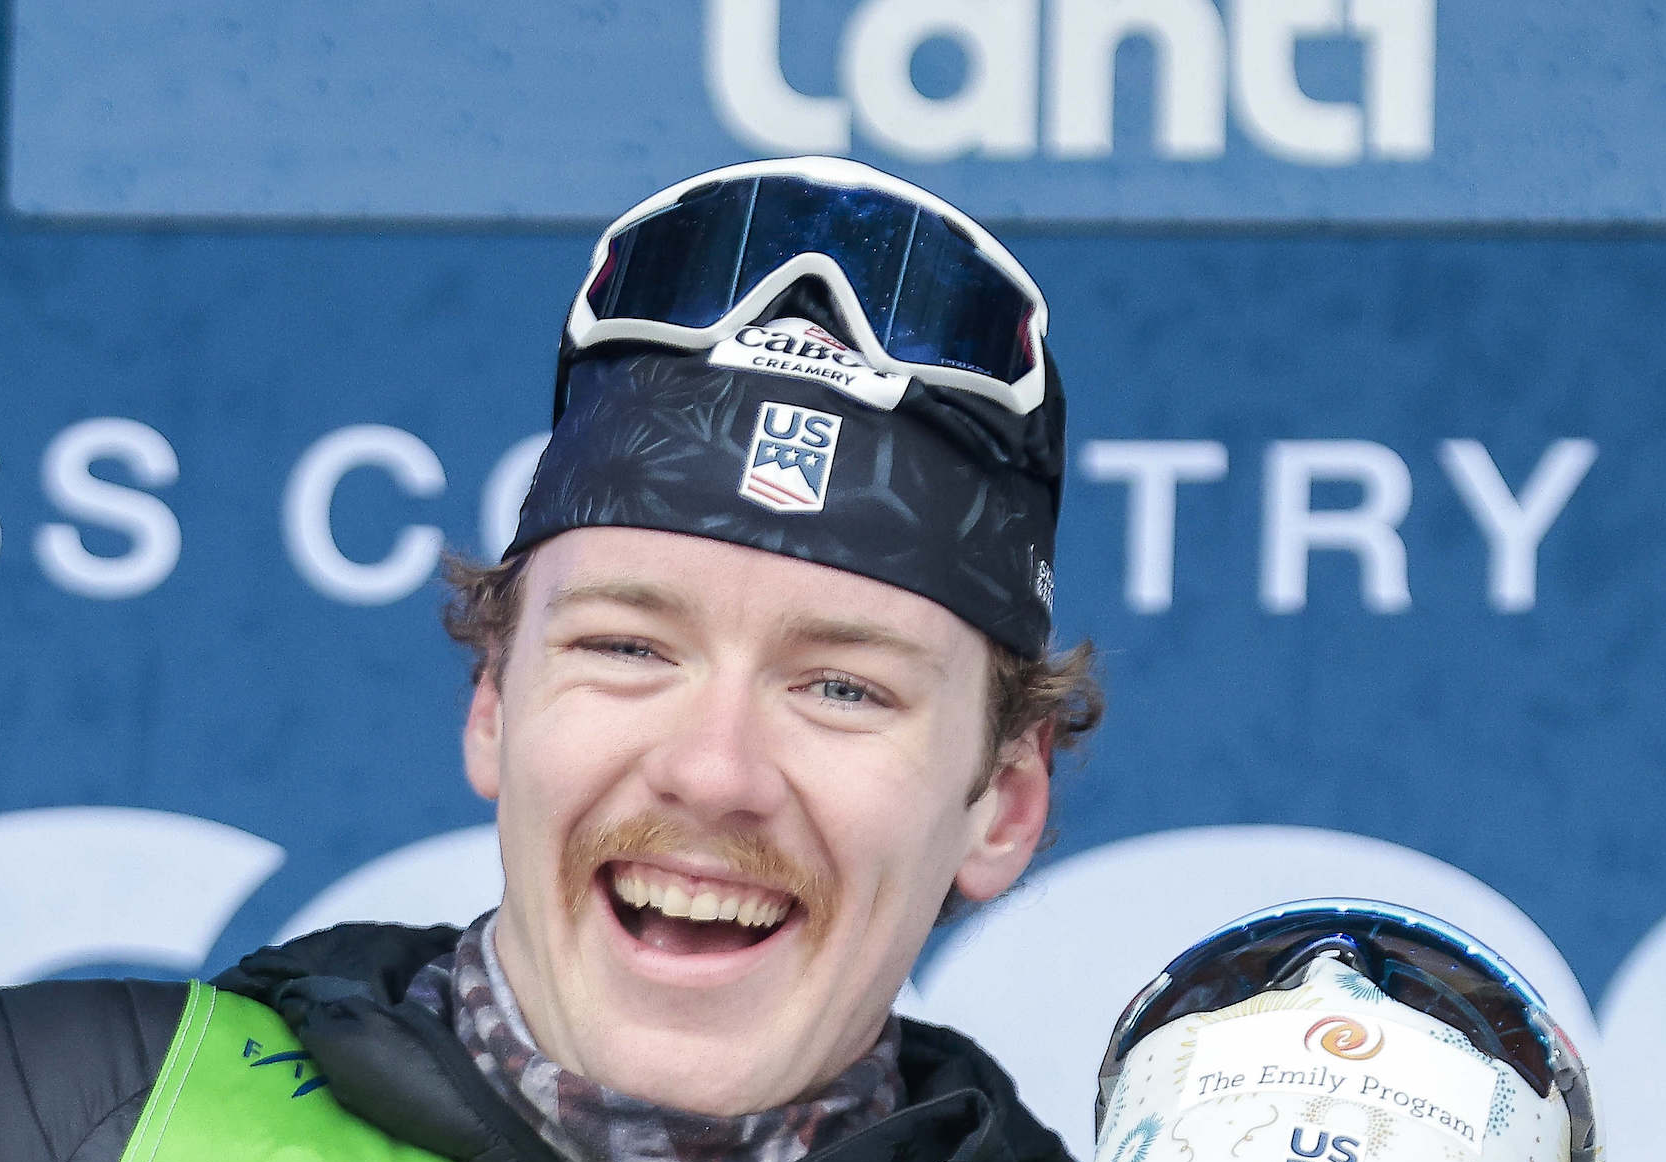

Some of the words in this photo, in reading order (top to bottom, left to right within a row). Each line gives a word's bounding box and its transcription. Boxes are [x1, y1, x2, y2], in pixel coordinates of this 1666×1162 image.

[752, 356, 858, 386] CREAMERY
[763, 406, 834, 449] US
[1199, 1071, 1245, 1096] The
[1258, 1065, 1347, 1094] Emily
[1360, 1075, 1478, 1142] Program
